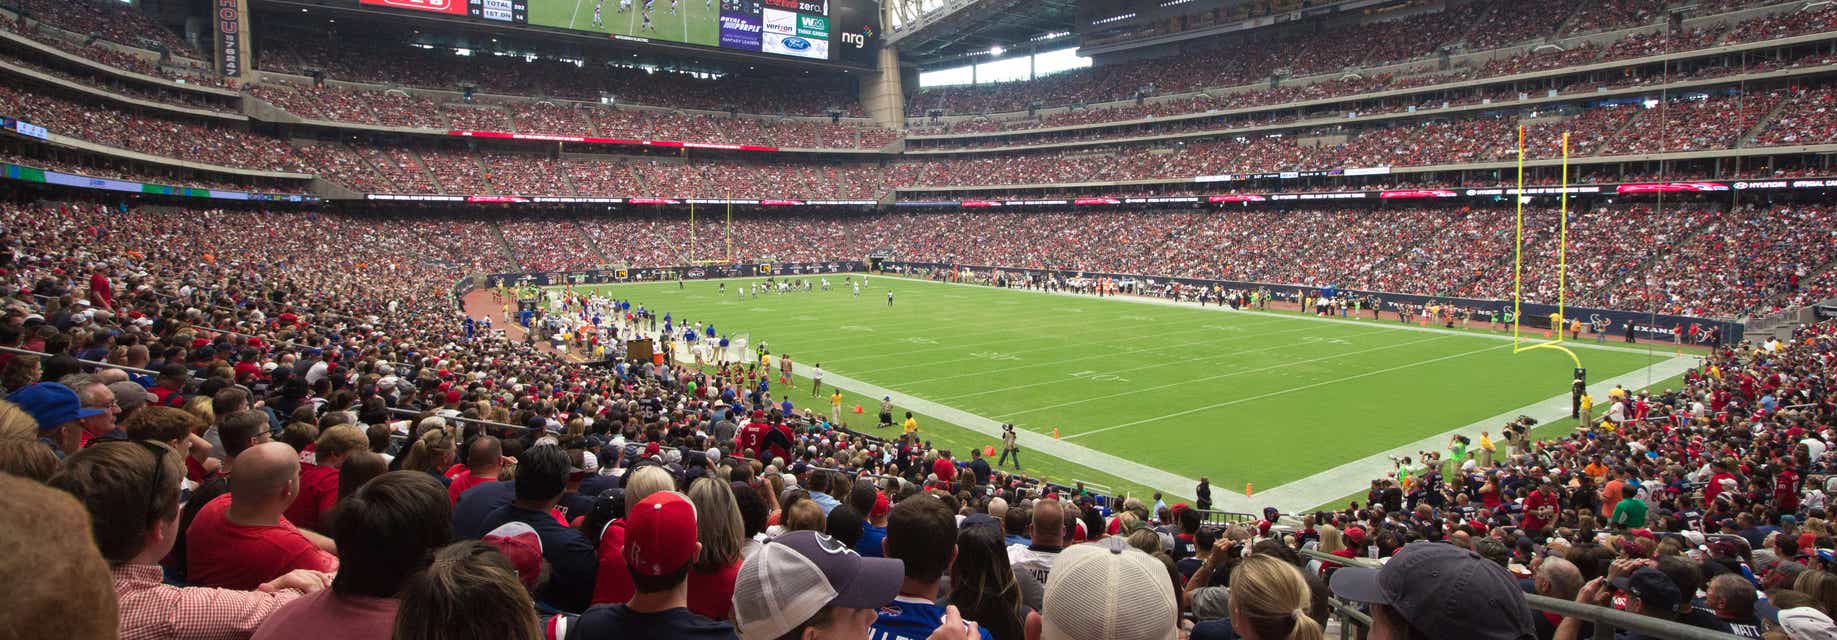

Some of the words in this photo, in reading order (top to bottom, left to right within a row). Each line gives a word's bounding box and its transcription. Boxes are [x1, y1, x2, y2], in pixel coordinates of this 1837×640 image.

[766, 23, 793, 32] verizon
[841, 31, 864, 48] nrg
[750, 434, 756, 446] 3
[1729, 622, 1761, 638] WATT
